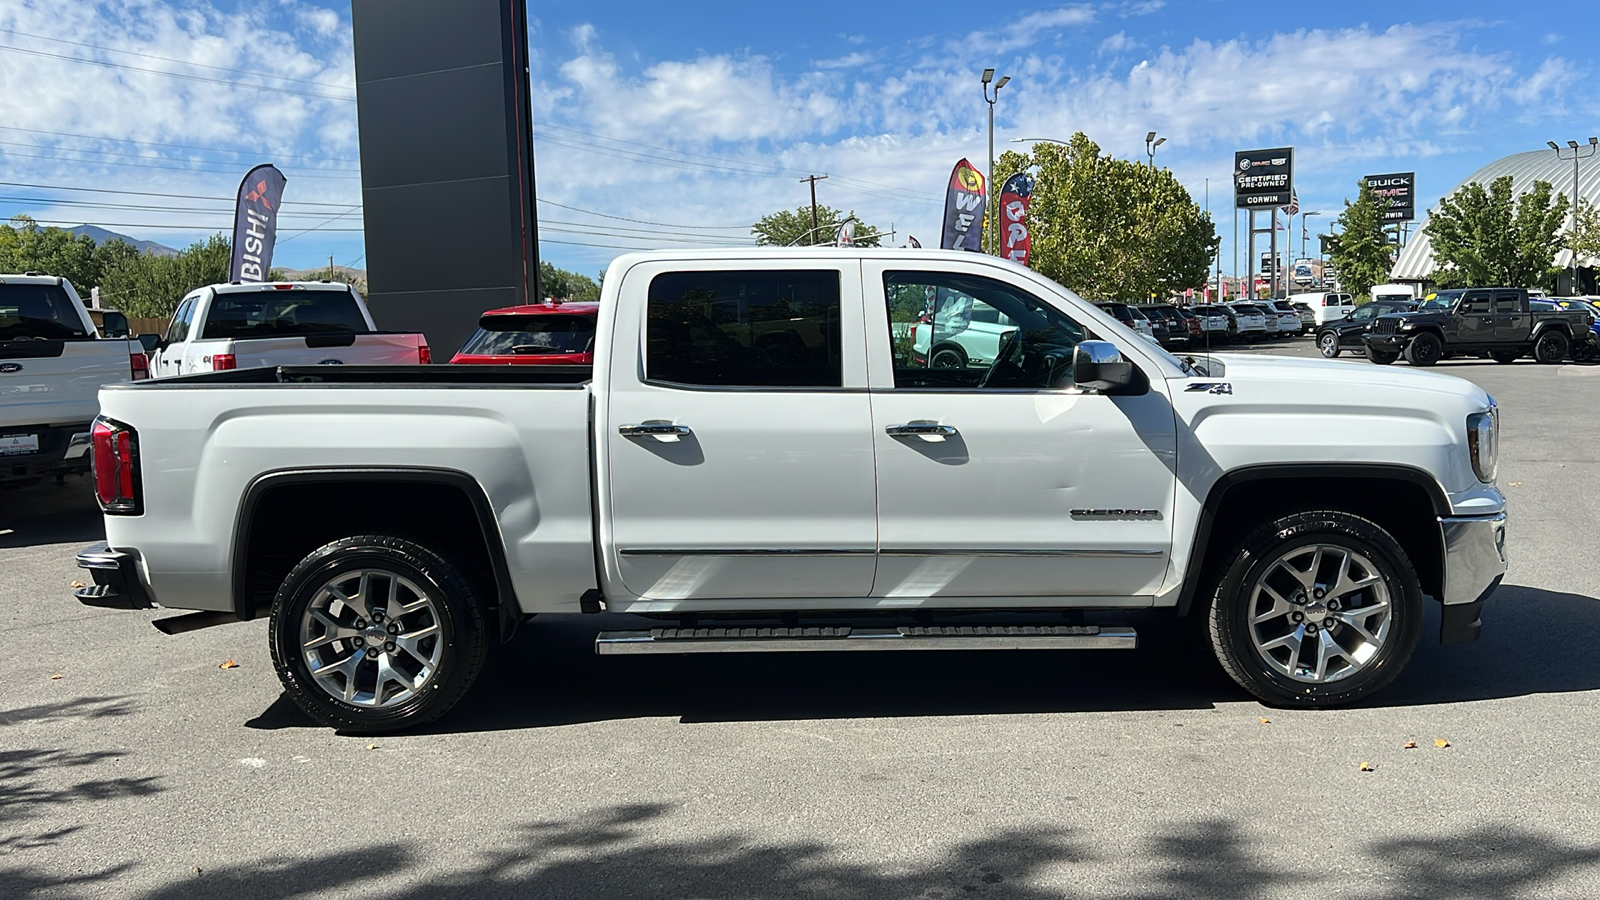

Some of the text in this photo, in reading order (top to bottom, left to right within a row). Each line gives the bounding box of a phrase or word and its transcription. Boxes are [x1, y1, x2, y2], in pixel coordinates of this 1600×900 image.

[1238, 174, 1288, 183] CERTIFIED
[1368, 177, 1410, 187] BUICK
[1241, 180, 1285, 189] PRE-OWNED
[1247, 195, 1278, 204] CORWIN
[1385, 211, 1403, 219] RWIN
[240, 208, 269, 284] BISHI
[1069, 508, 1161, 519] SIERRA
